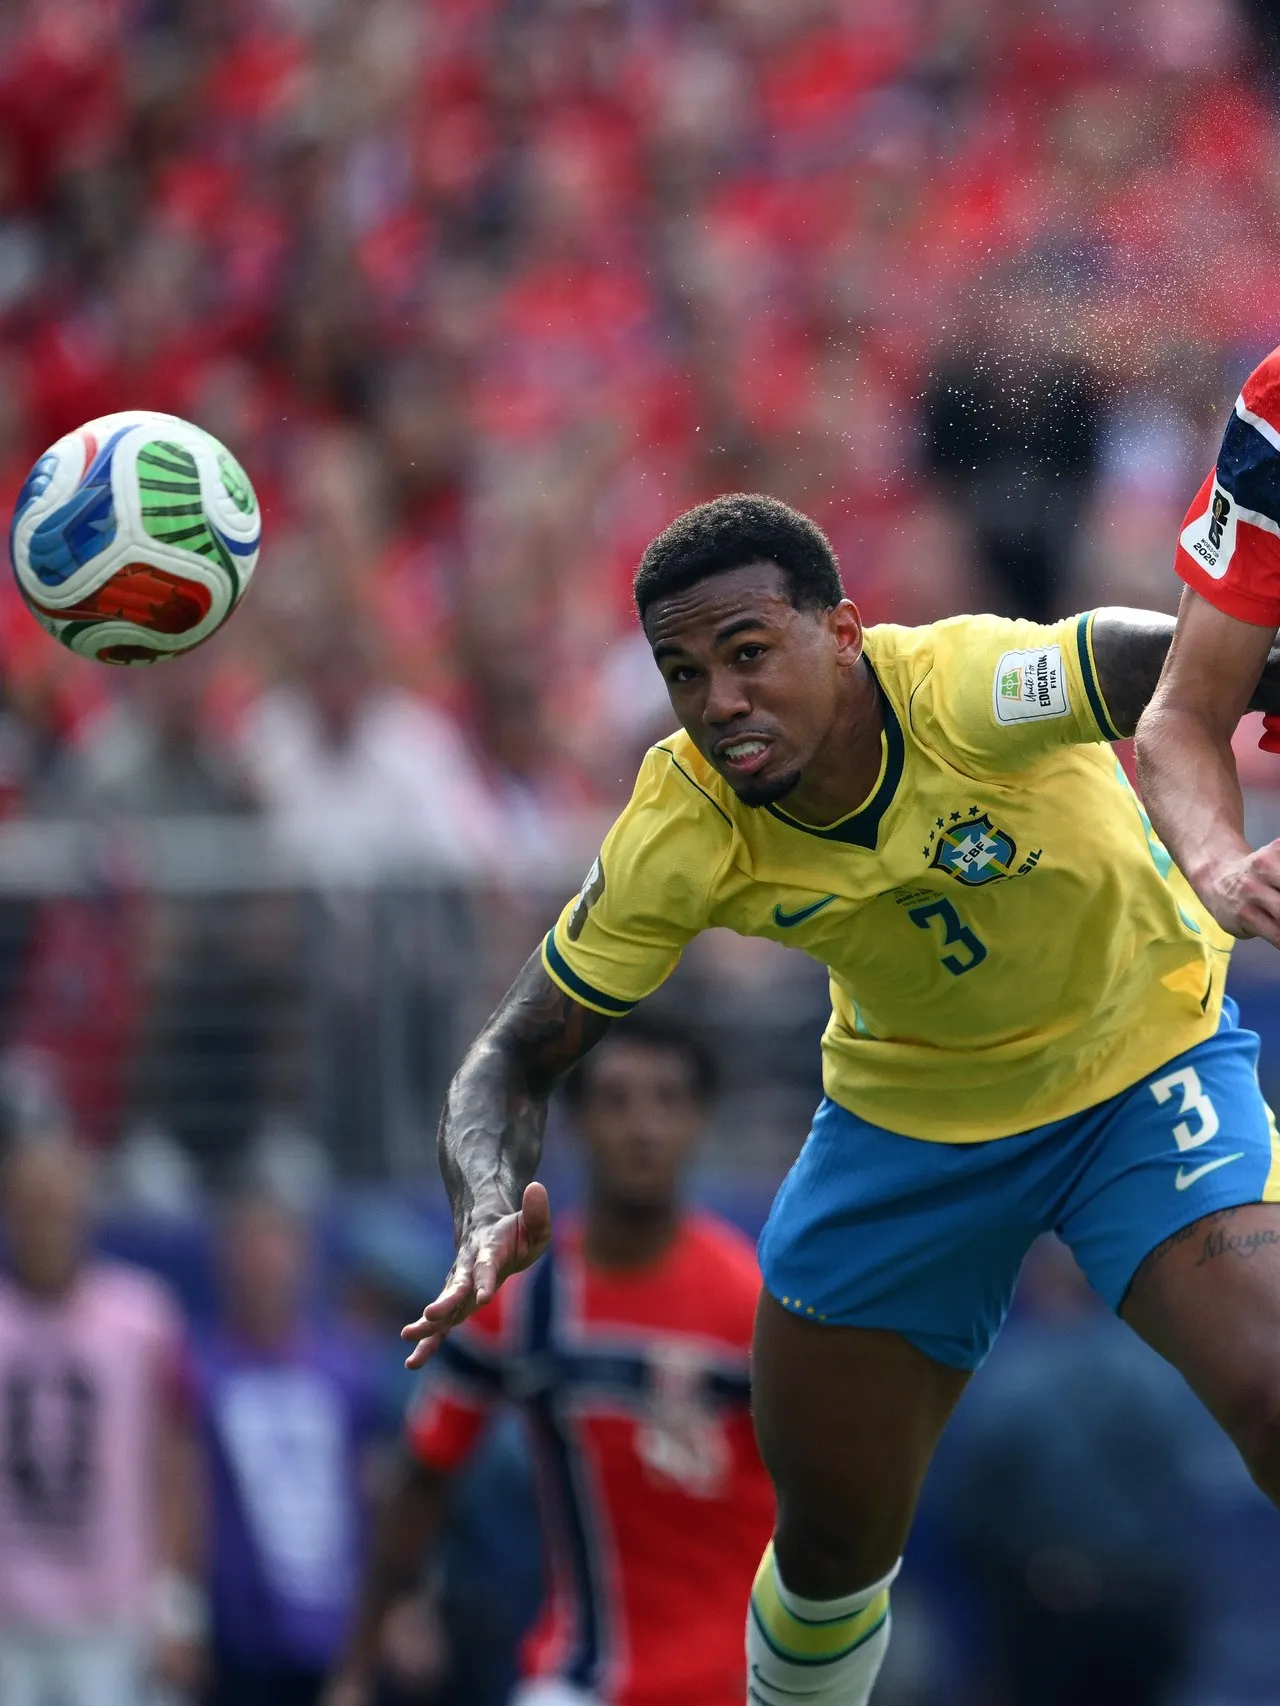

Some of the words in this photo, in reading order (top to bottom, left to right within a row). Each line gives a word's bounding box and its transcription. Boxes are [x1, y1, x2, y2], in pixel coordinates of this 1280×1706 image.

[1193, 542, 1217, 566] 2026
[1024, 677, 1037, 703] Unite
[1037, 654, 1051, 707] EDUCATION
[962, 841, 985, 864] CBF
[1017, 848, 1043, 876] SIL
[908, 897, 987, 977] 3
[1150, 1066, 1220, 1152] 3
